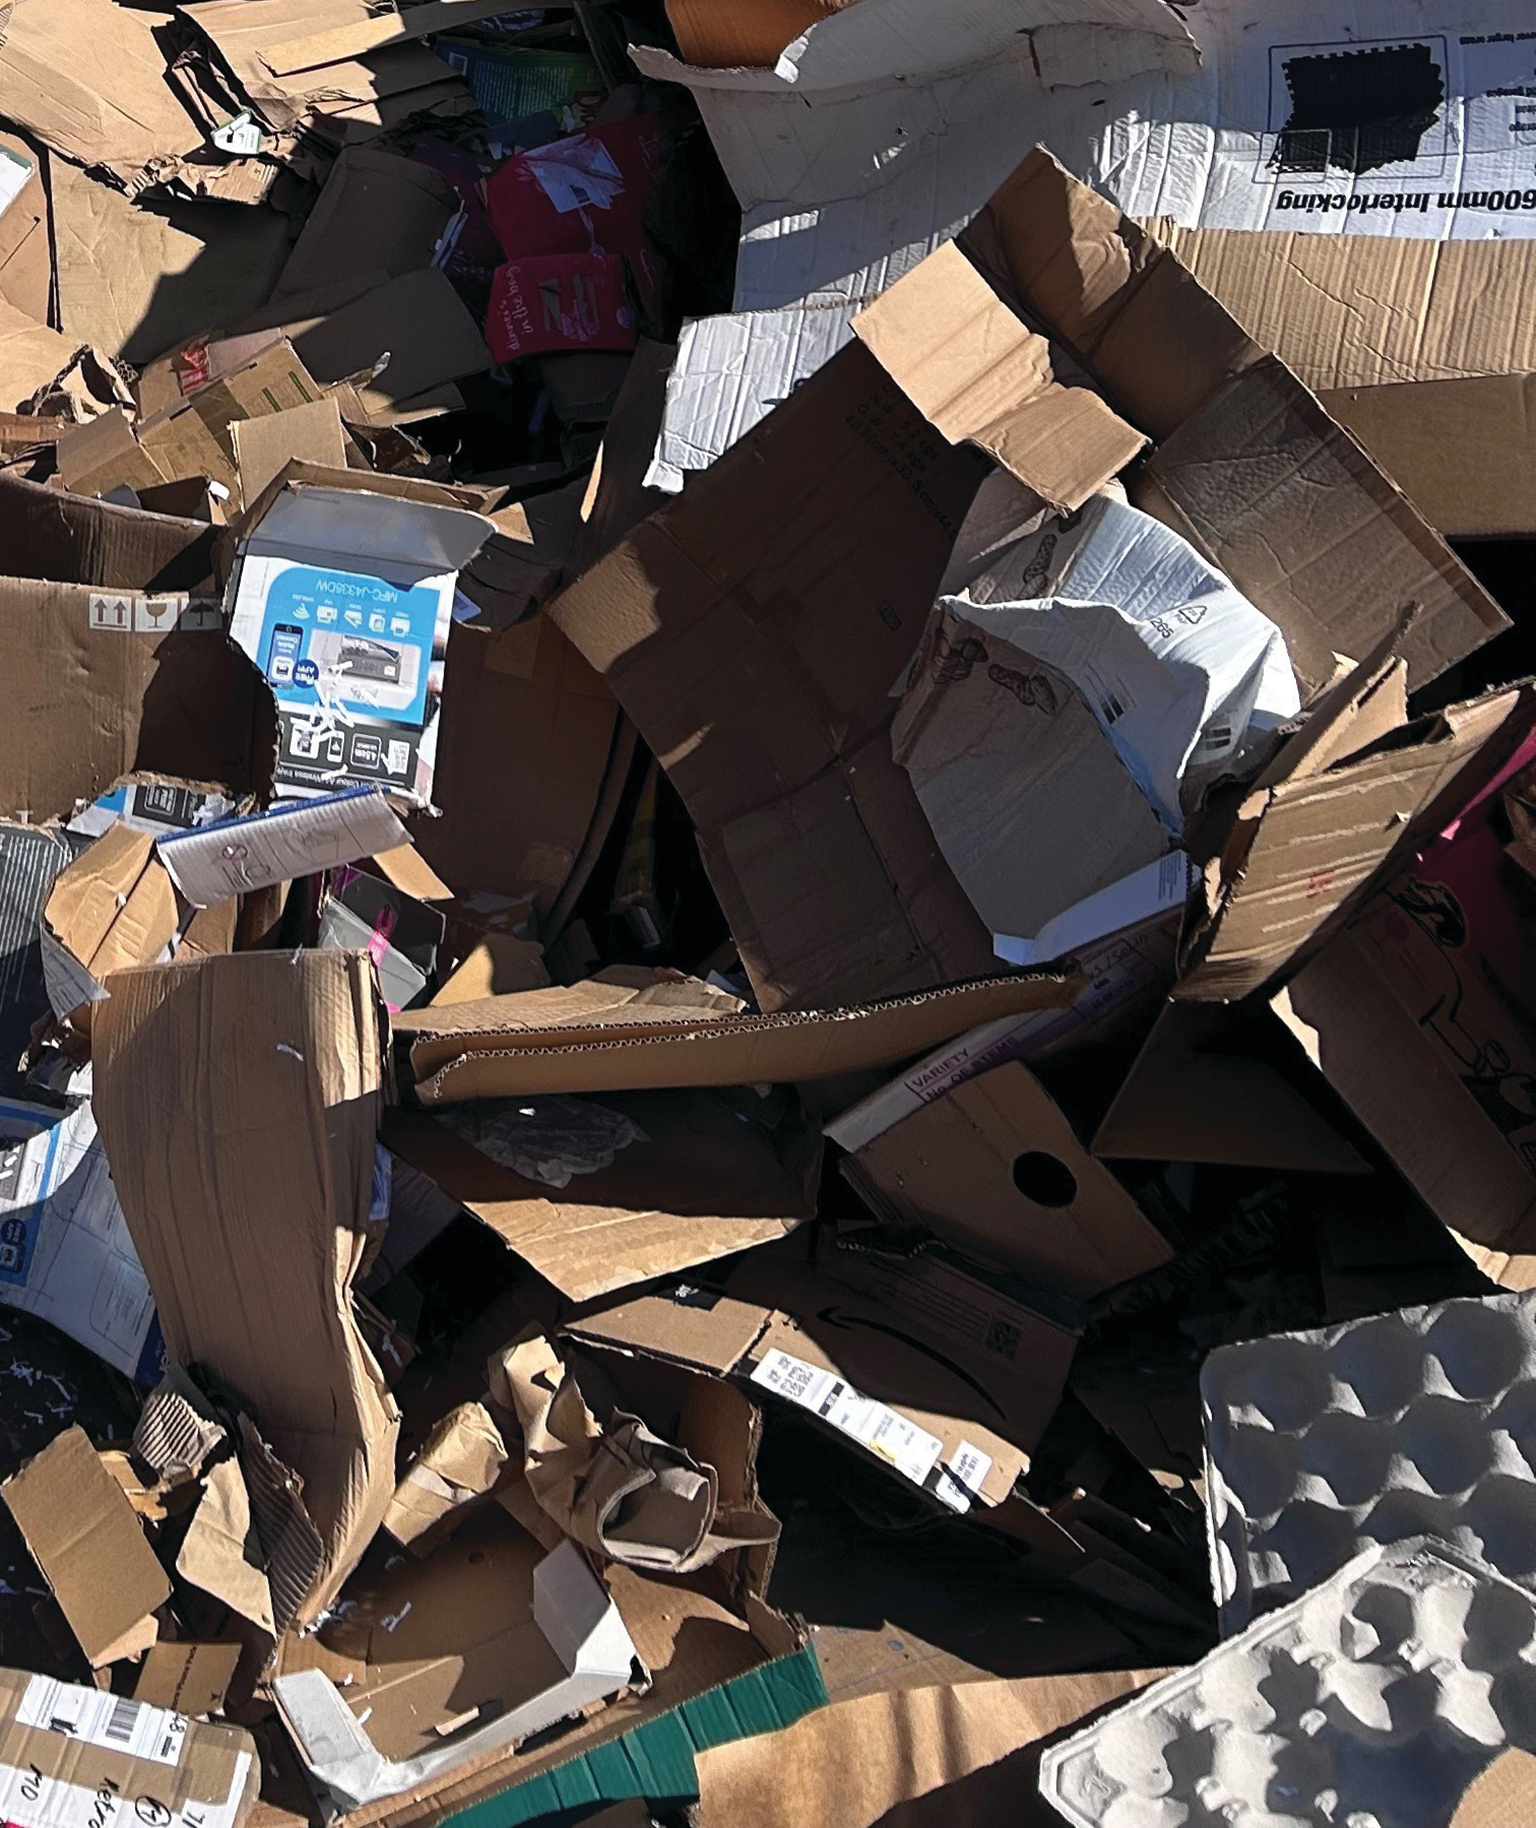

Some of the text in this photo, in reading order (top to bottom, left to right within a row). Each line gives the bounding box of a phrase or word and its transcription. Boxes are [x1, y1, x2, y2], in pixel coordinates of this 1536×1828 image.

[1275, 189, 1536, 215] 600mm Interlocking
[912, 1048, 970, 1089] VARIETY
